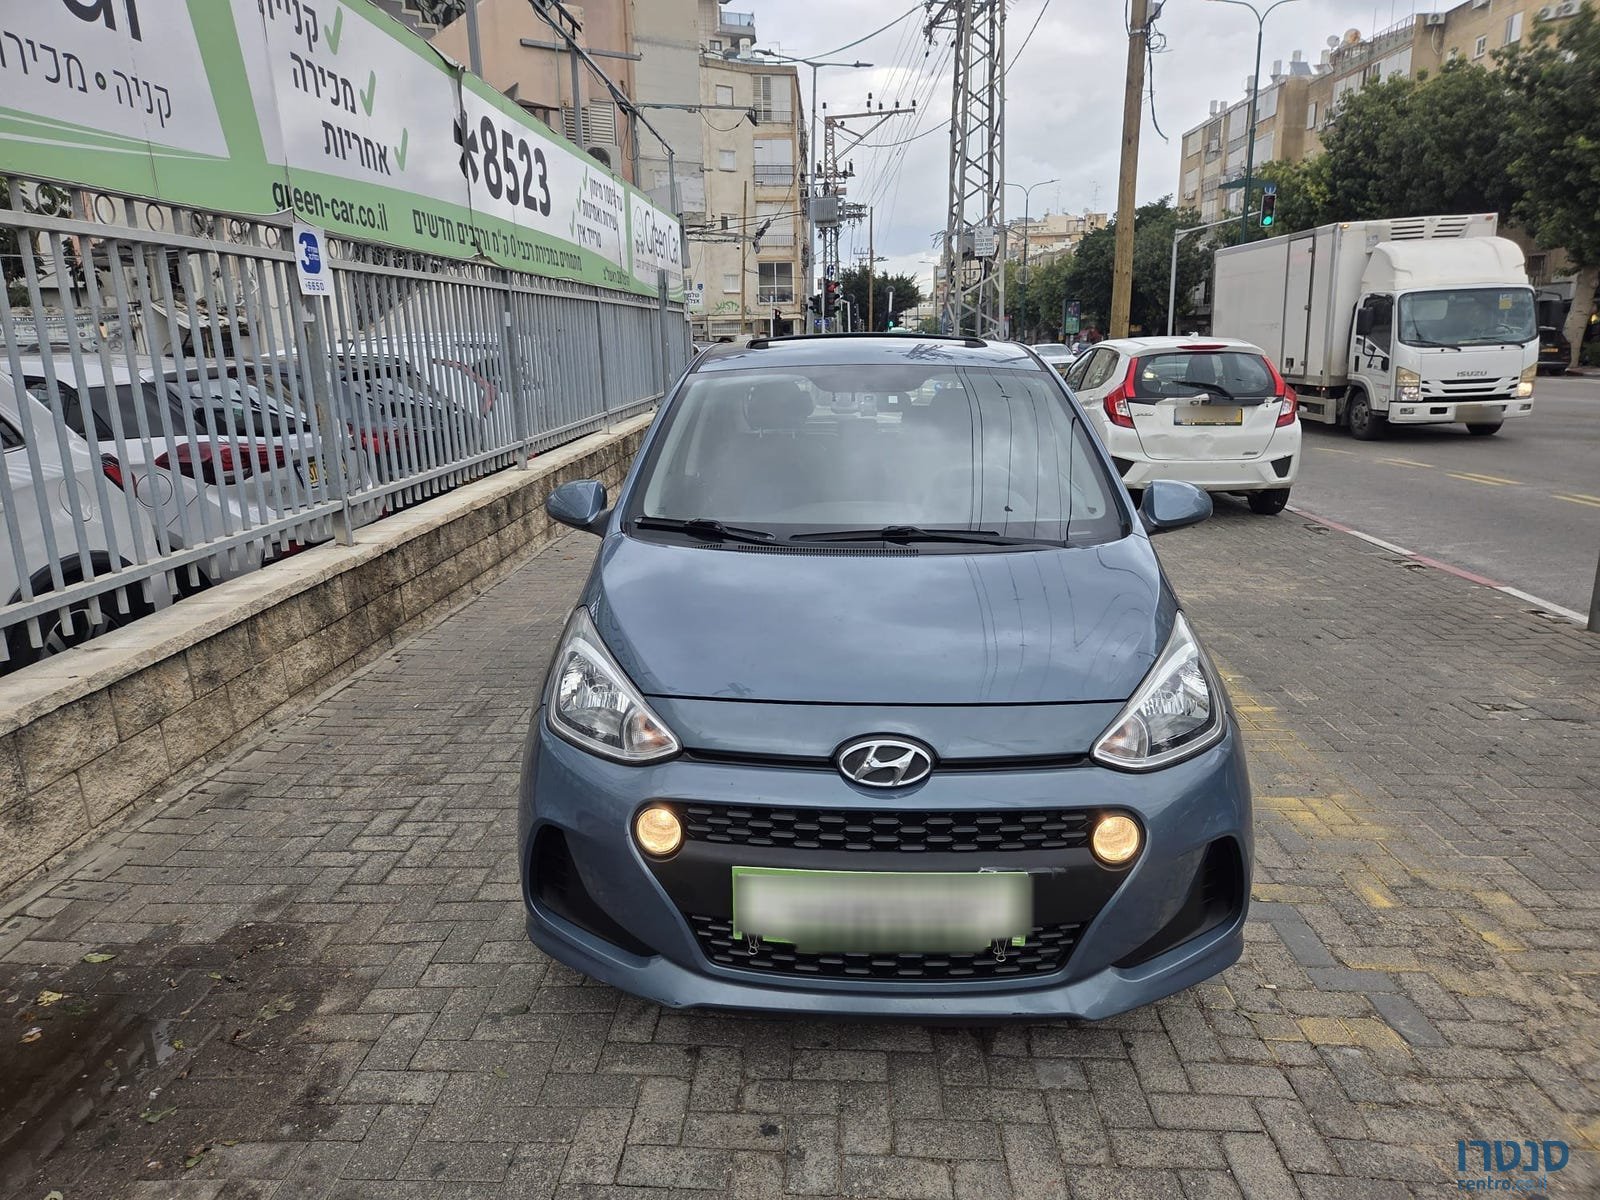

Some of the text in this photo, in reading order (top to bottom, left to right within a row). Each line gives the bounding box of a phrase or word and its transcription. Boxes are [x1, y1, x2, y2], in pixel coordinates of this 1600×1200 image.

[0, 30, 172, 128] קניה מכיר
[290, 51, 357, 115] מכירה
[321, 119, 391, 176] אחריות
[271, 181, 389, 232] green-car.co.il
[412, 208, 456, 243] חדשים
[457, 221, 491, 251] ורכבים
